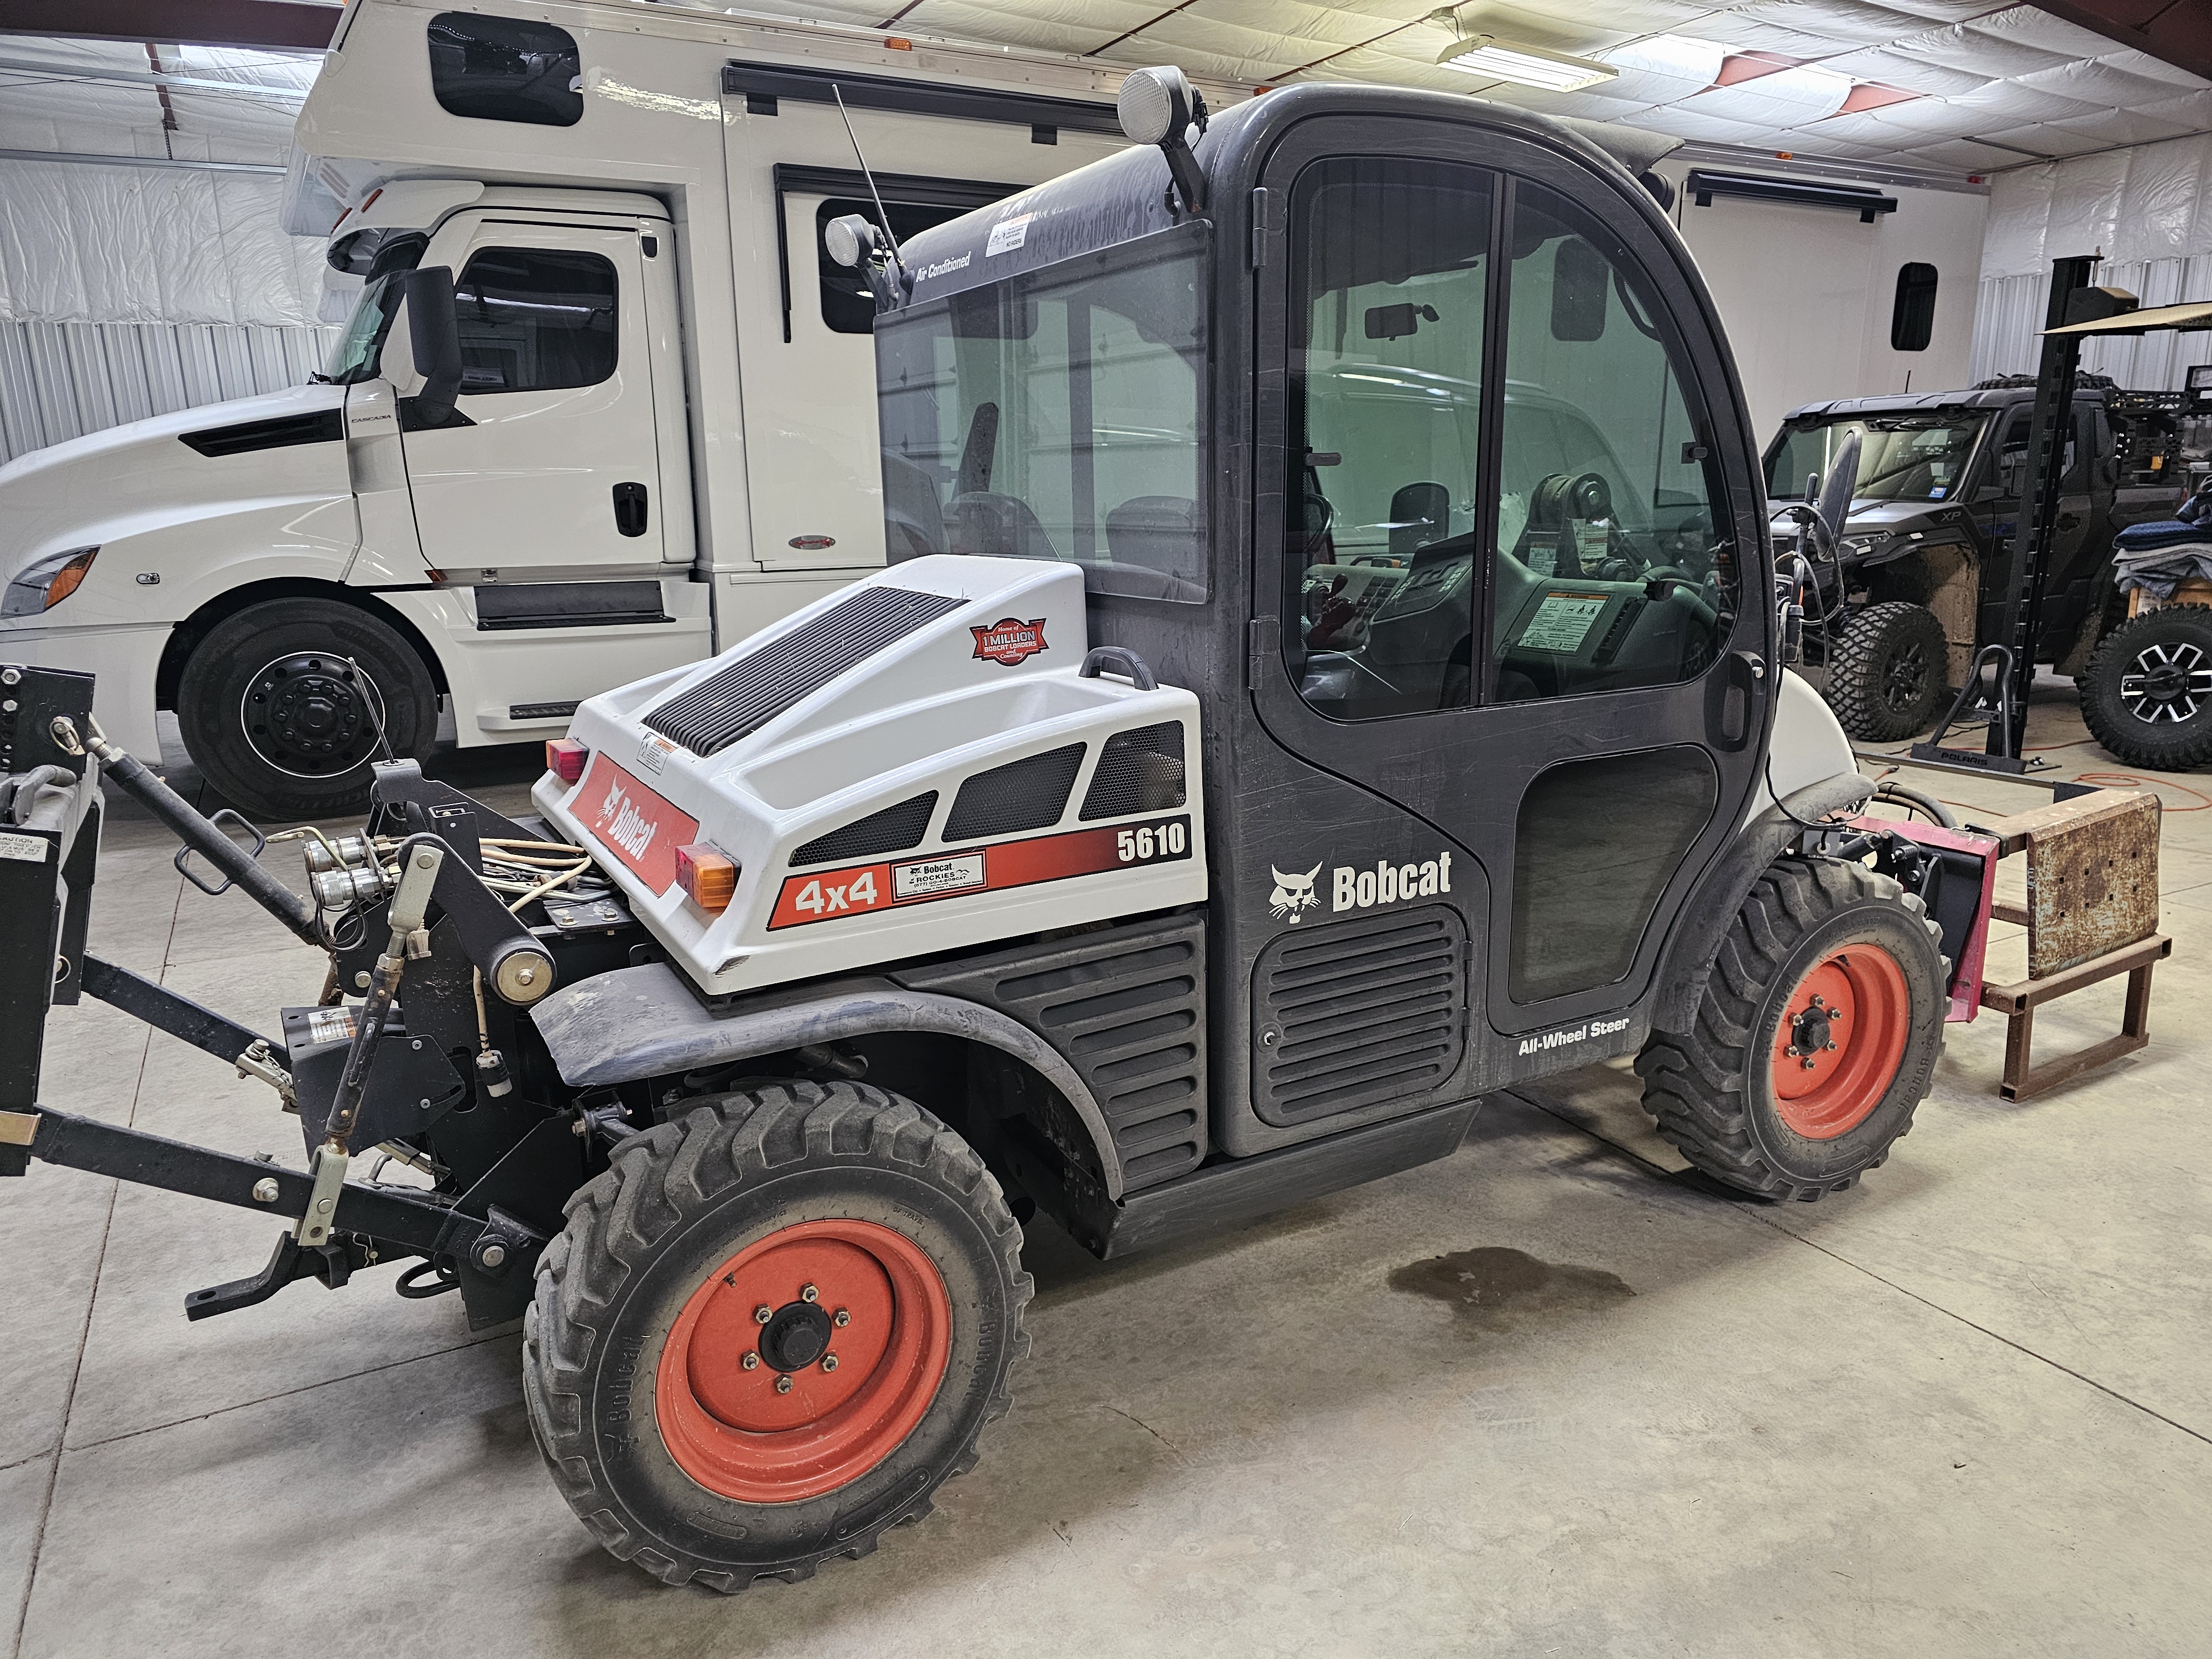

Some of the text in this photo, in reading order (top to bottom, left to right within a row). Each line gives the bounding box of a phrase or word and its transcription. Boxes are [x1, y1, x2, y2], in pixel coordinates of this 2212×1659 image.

[916, 251, 971, 283] Air Conditioned
[351, 415, 392, 423] CASCADIA
[1941, 512, 1961, 522] XP
[983, 630, 1035, 646] 1 MILLION
[1010, 640, 1037, 649] LOADERS
[1941, 752, 1988, 766] POLARIS
[607, 796, 658, 860] Bobcat
[1117, 822, 1186, 862] 5610
[924, 863, 952, 874] Bobcat
[916, 872, 955, 883] ROCKIES
[929, 876, 966, 884] GO-4-BOBCAT
[1333, 851, 1452, 912] Bobcat
[795, 870, 878, 915] 4x4
[1519, 1018, 1630, 1056] All-Wheel Steer
[903, 1211, 924, 1225] TRAVEL
[691, 1261, 705, 1275] NOT
[722, 1224, 756, 1248] HIGHWAY
[759, 1209, 787, 1226] SERVICE
